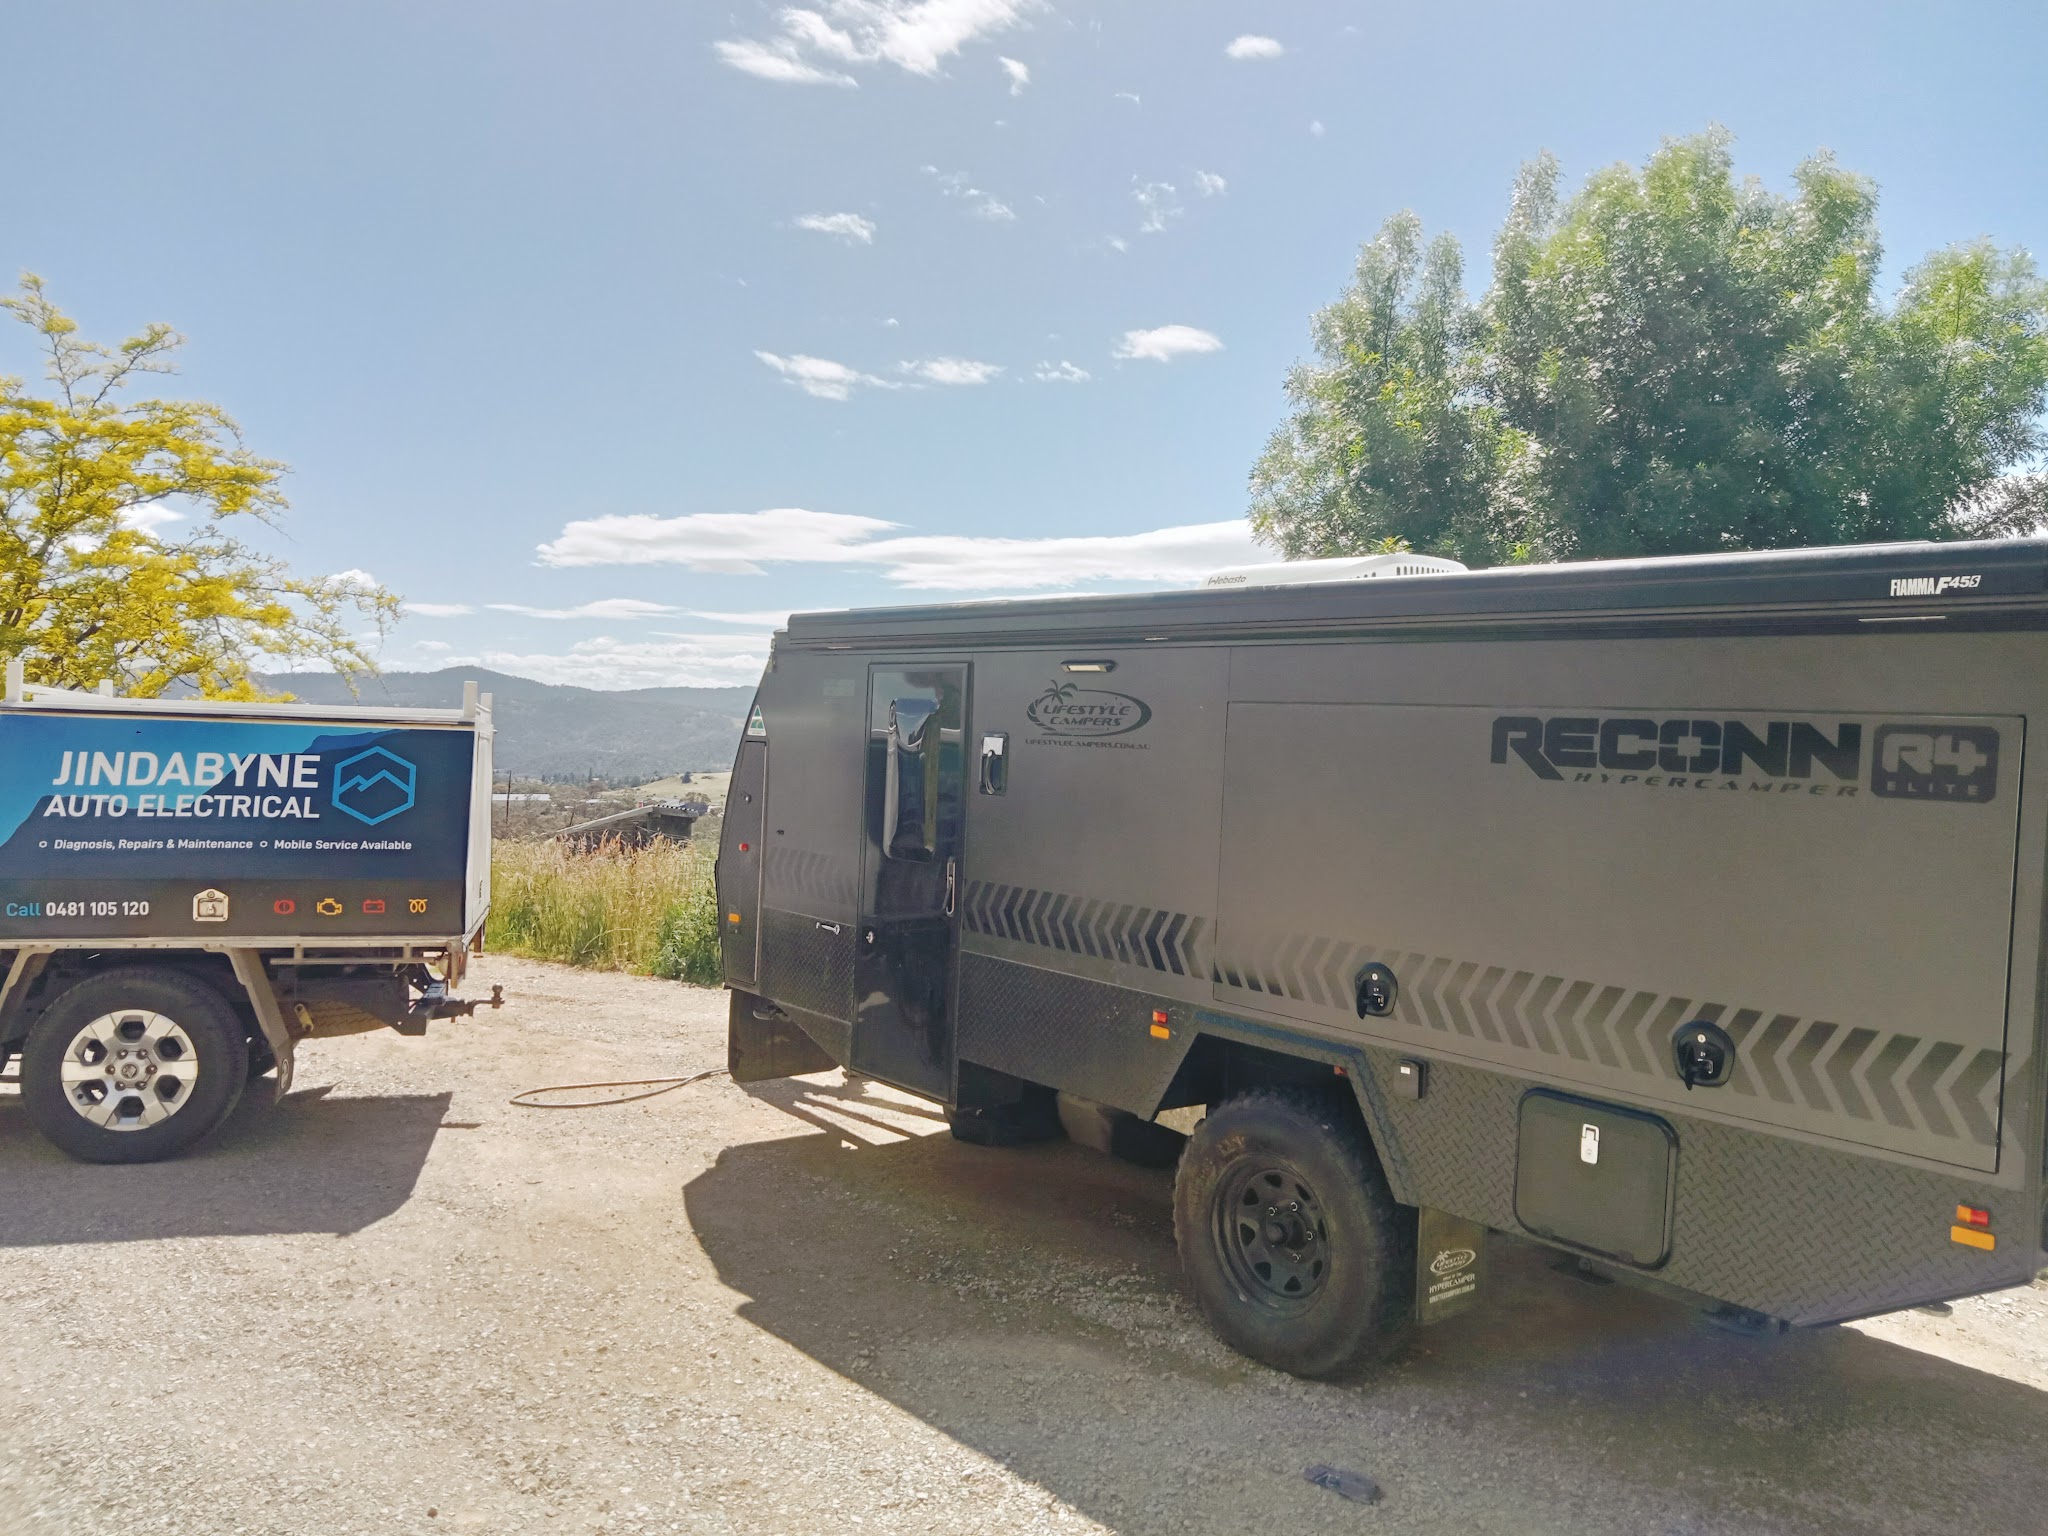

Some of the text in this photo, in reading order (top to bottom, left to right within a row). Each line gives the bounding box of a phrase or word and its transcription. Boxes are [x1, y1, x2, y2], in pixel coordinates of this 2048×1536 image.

[1890, 577, 1935, 597] FIAMMA
[1043, 704, 1132, 716] LIFESTYLE
[1050, 716, 1121, 727] CAMPERS
[1491, 716, 1862, 781] RECONN
[1881, 733, 1988, 776] R4
[52, 751, 321, 789] JINDABYNE
[1573, 772, 1859, 797] HYPERCAMPER
[1887, 780, 1980, 796] ELITE
[43, 794, 320, 819] AUTO ELECTRICAL
[54, 839, 412, 850] Diagnosis, Repairs & Maintenance Mobile Service Available
[6, 901, 150, 917] Call 0481 105 120
